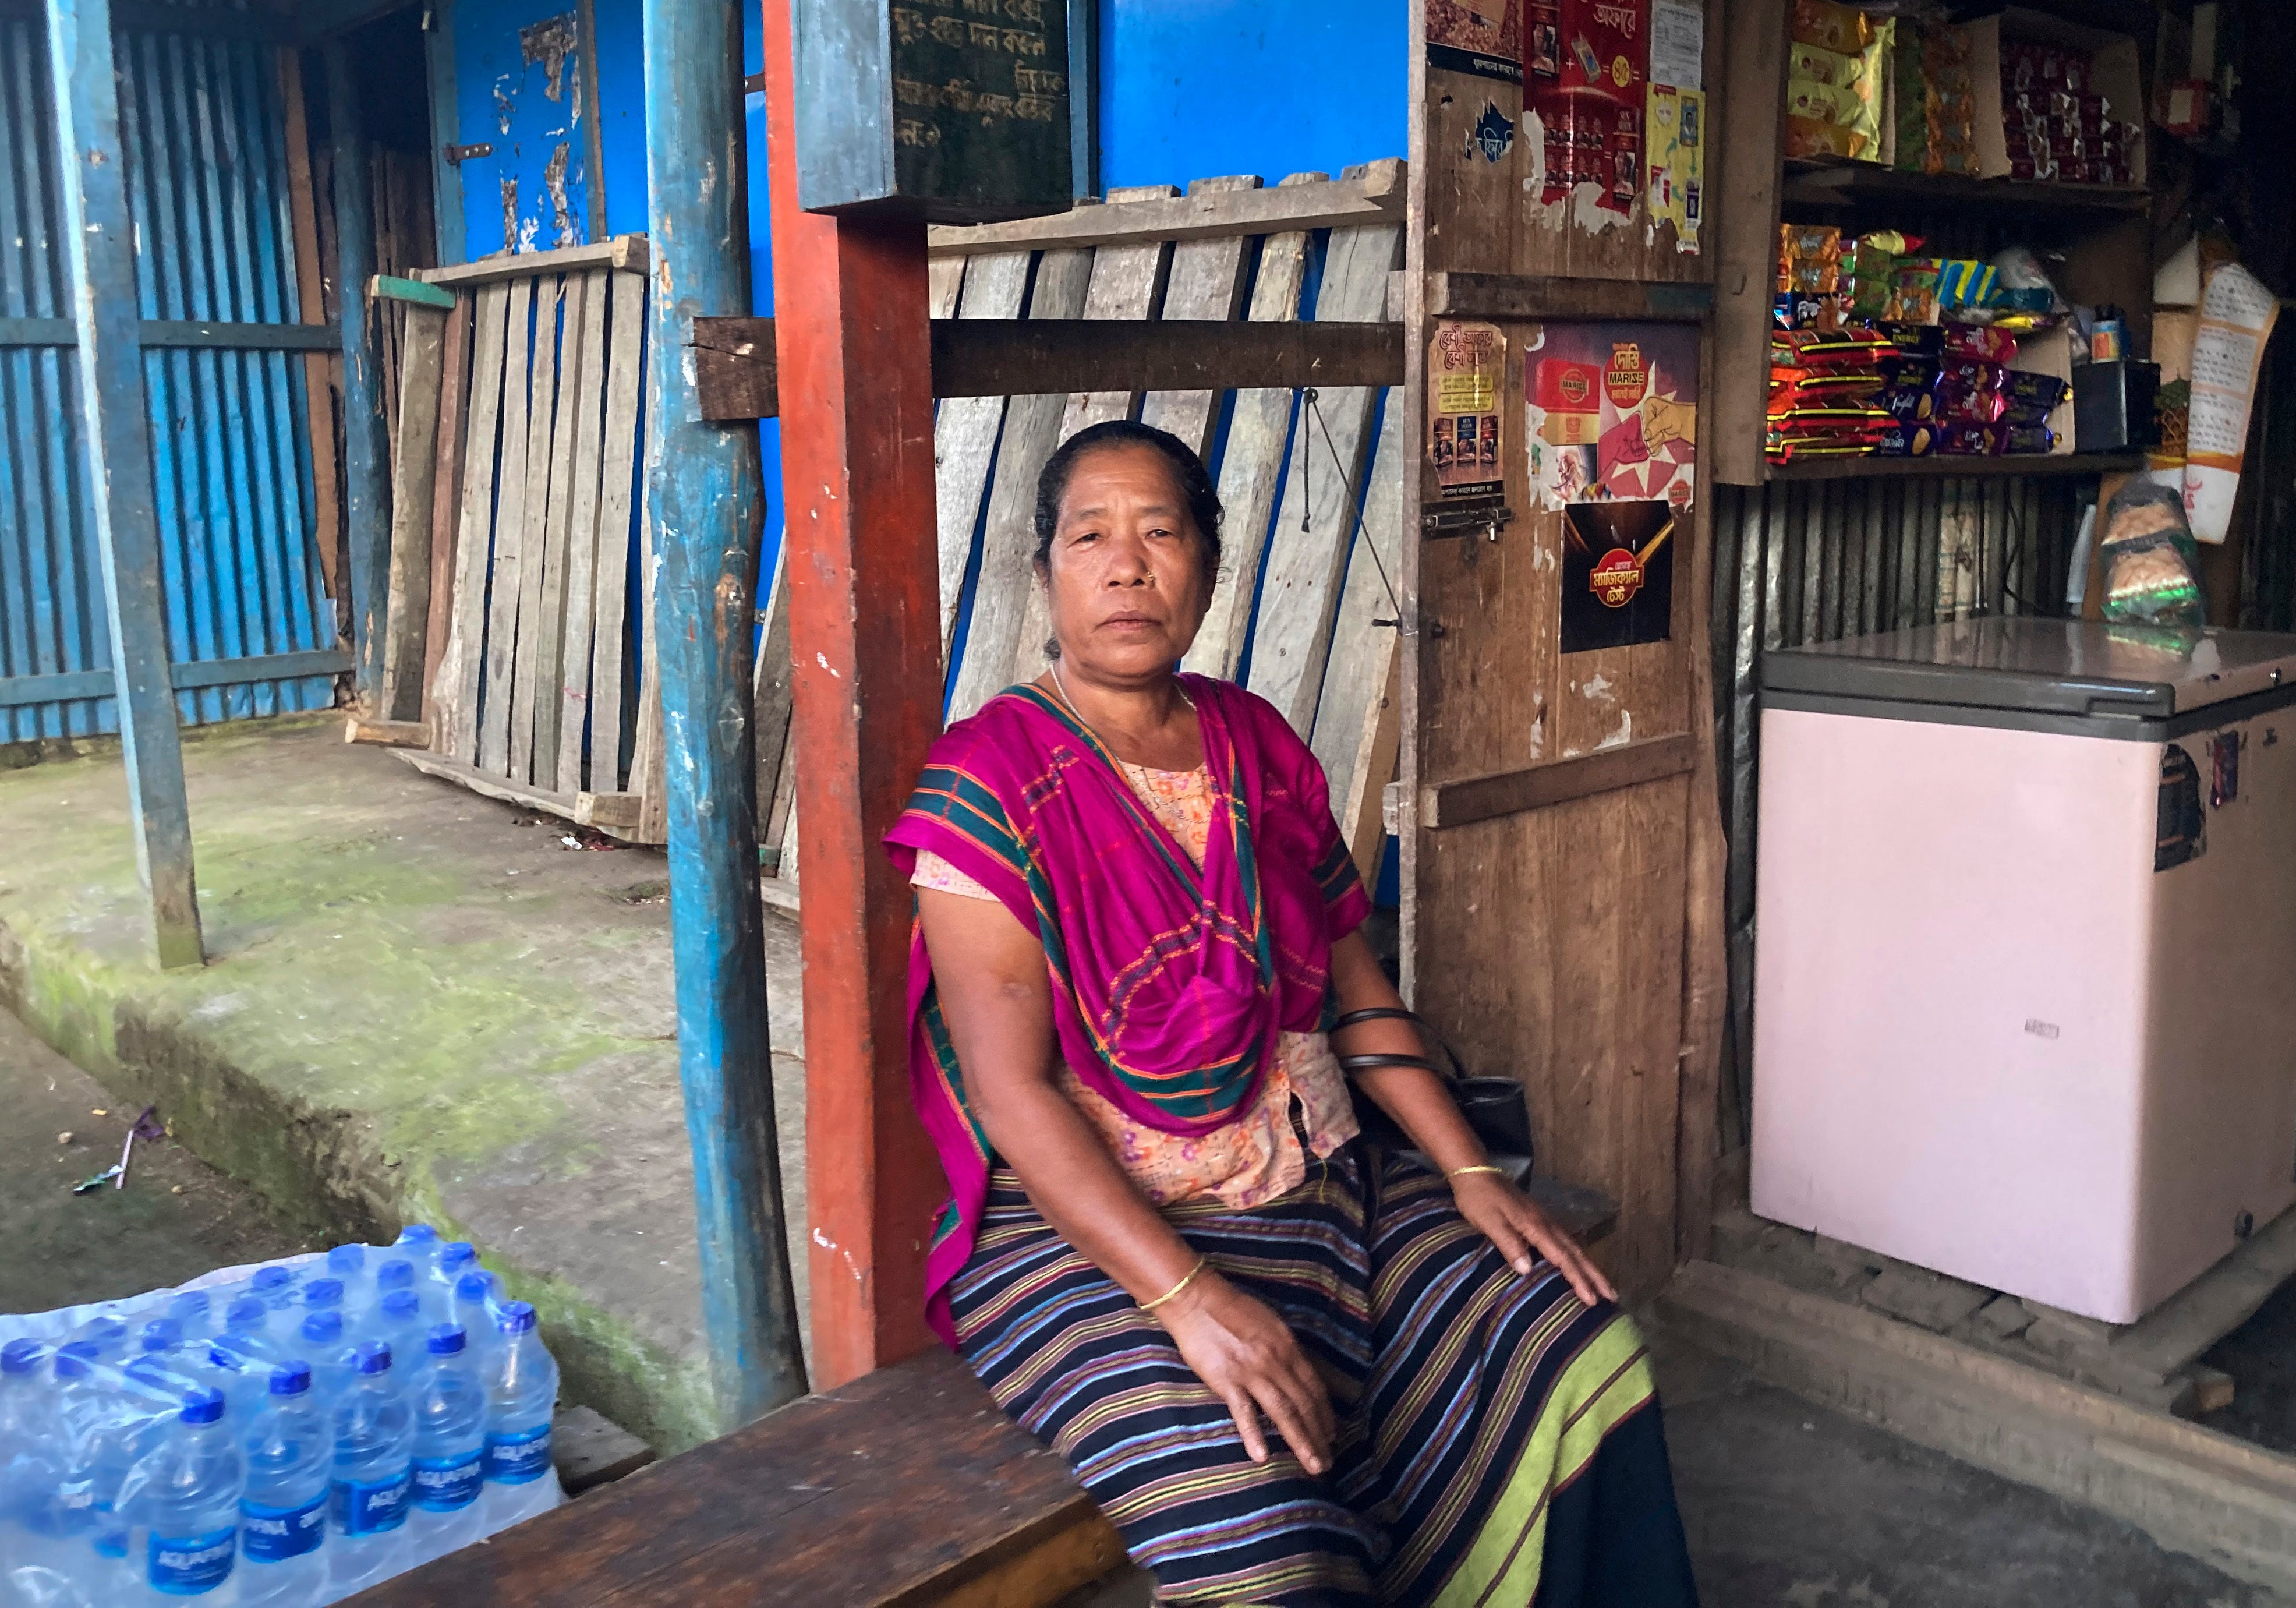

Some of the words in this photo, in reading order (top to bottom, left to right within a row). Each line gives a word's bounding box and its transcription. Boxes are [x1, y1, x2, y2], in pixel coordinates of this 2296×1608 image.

[1593, 3, 1636, 40] অফারে
[1439, 323, 1461, 349] বেশী
[1463, 331, 1493, 346] অফার
[1444, 343, 1466, 370] বেশী
[1609, 373, 1643, 384] MARISE
[1593, 567, 1639, 587] ম্যাজিক্যাল
[1607, 585, 1625, 602] টেস্ট
